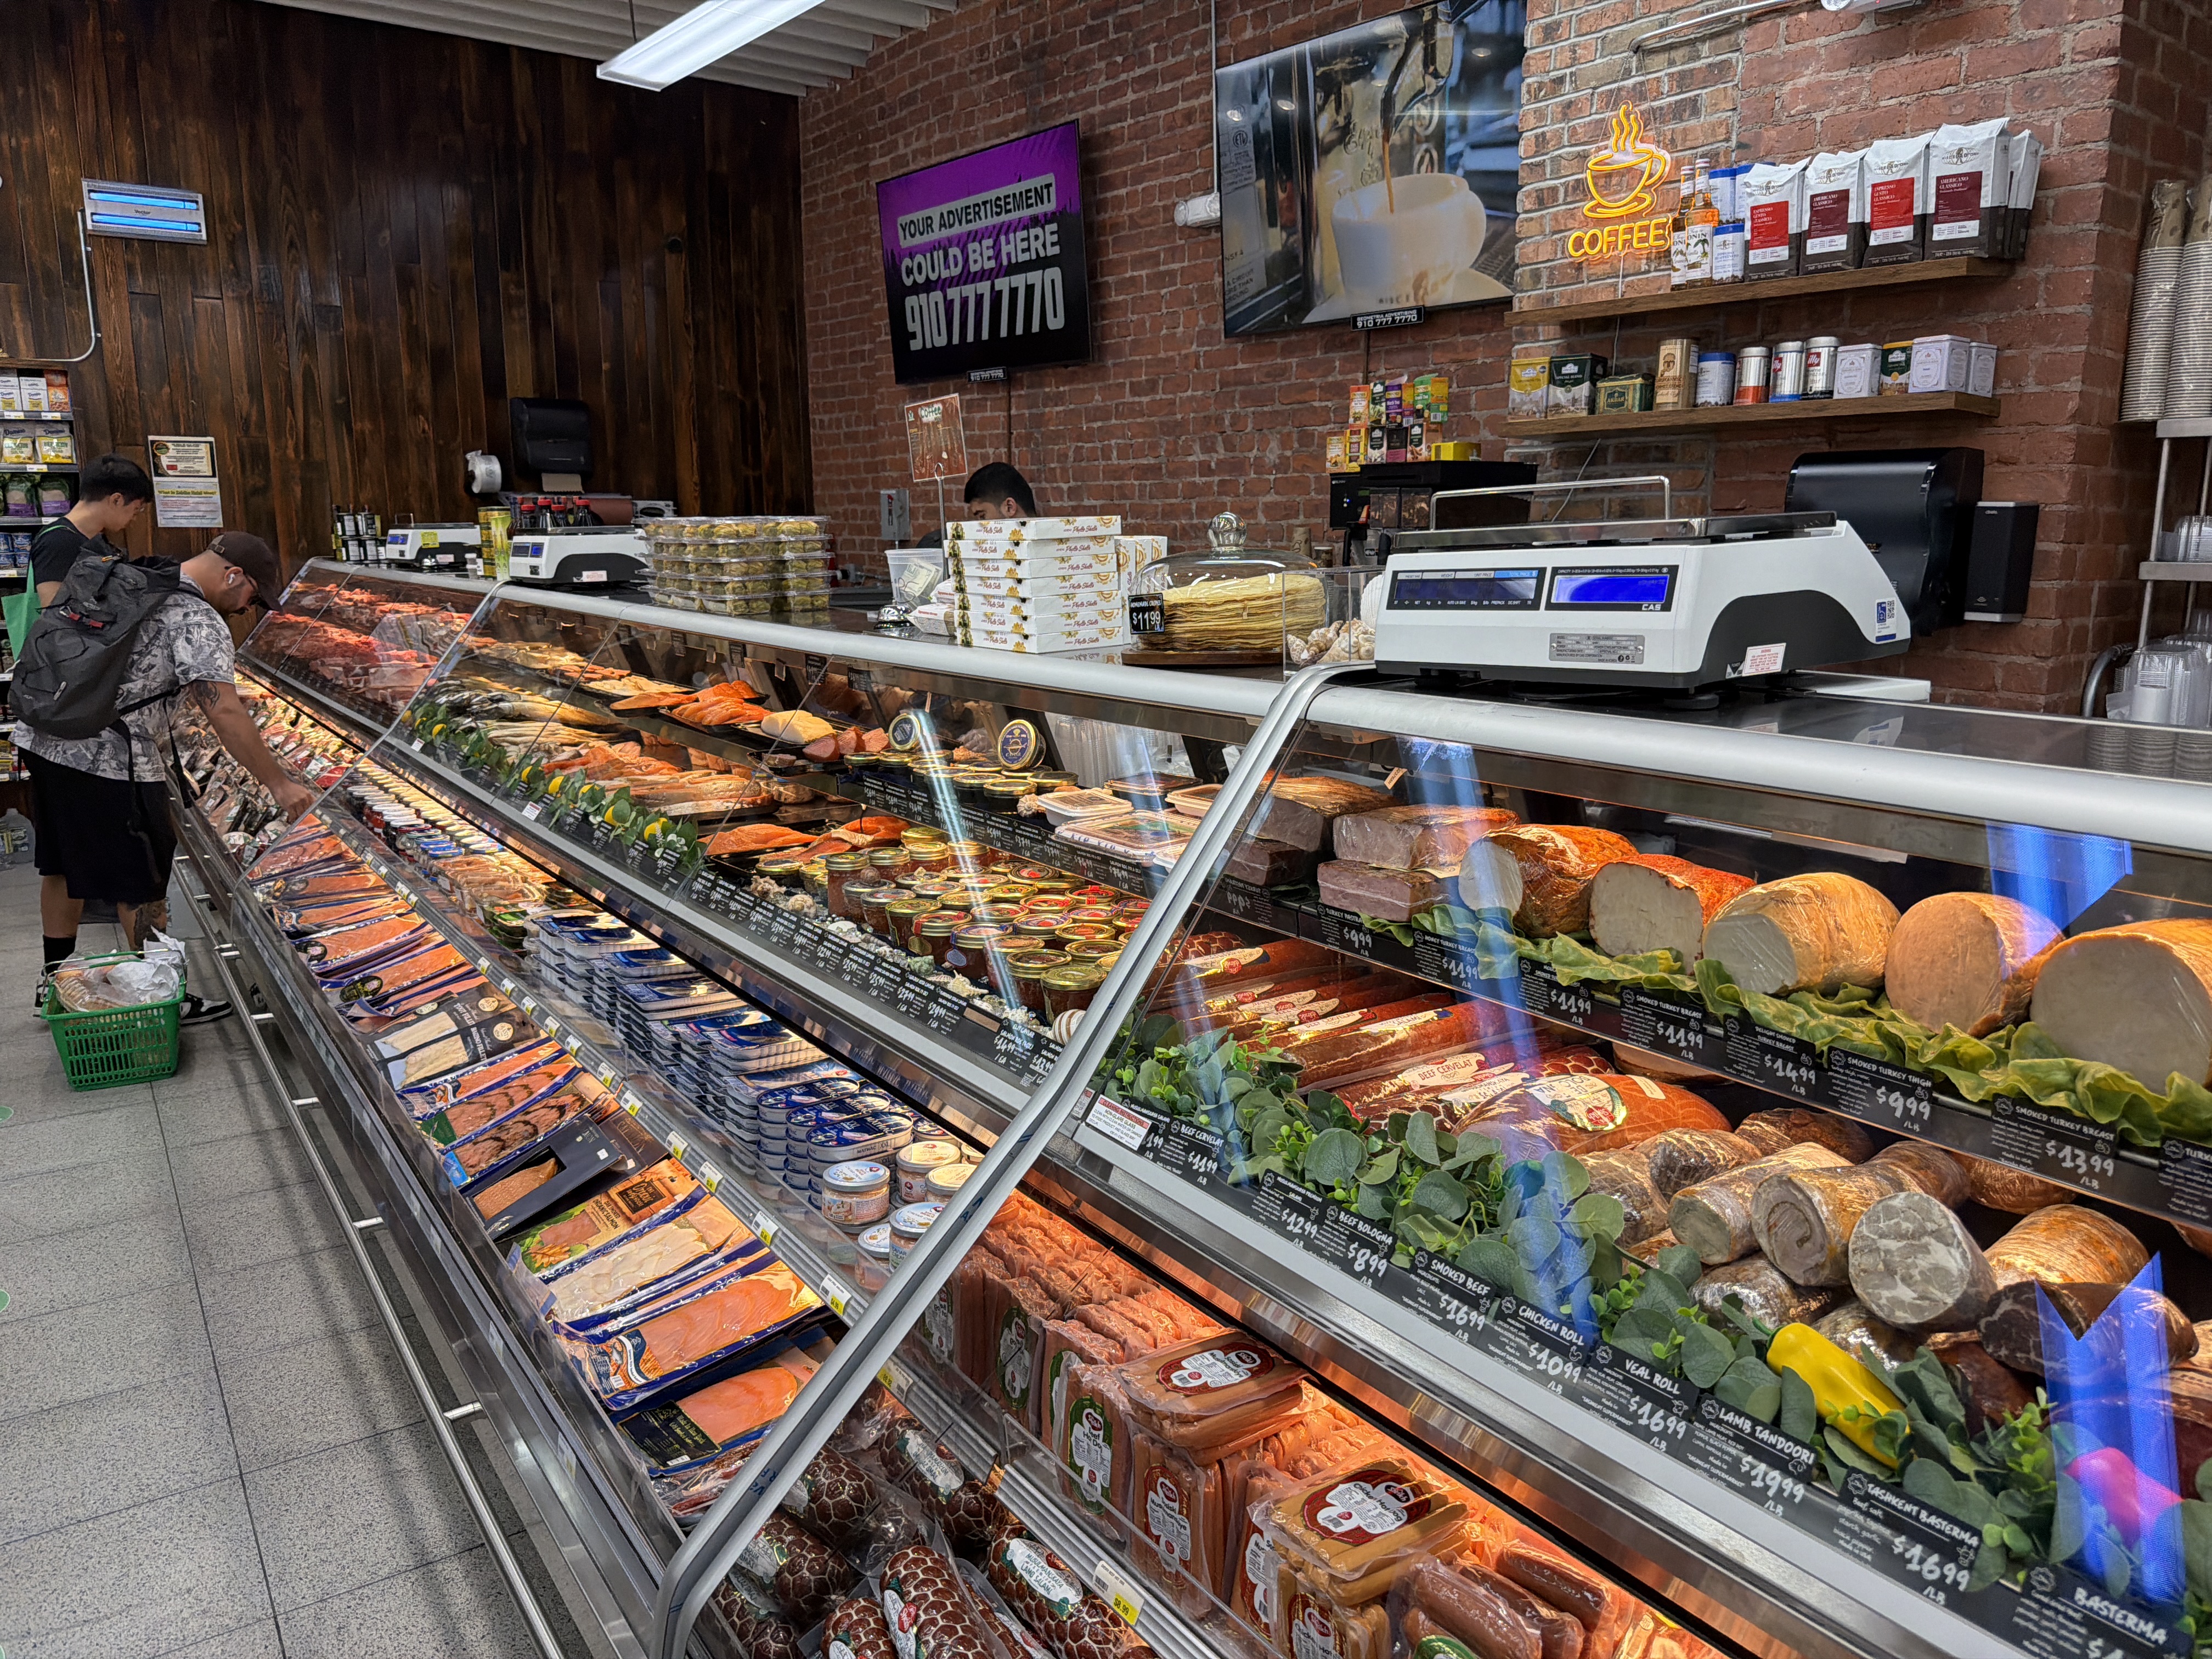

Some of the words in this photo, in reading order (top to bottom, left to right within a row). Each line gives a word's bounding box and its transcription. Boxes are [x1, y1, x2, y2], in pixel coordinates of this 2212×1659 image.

[1940, 176, 1968, 184] AMERICANO
[899, 216, 934, 241] YOUR
[939, 183, 1053, 232] ADVERTISEMENT
[1568, 218, 1667, 258] COFFEE
[1688, 233, 1707, 241] ONIN
[901, 247, 962, 286] COULD
[968, 239, 996, 273] BE
[1001, 223, 1060, 266] HERE
[1357, 320, 1373, 328] 910
[1376, 318, 1392, 326] 777
[1394, 314, 1417, 324] 7770
[1385, 309, 1417, 318] ADVERTISING
[1808, 353, 1820, 366] illy
[920, 405, 941, 418] Coffee
[1133, 611, 1160, 630] $1199
[1326, 907, 1344, 919] TURKEY
[1344, 913, 1363, 923] PASTRA
[1344, 929, 1372, 949] $999
[1425, 935, 1438, 944] HONEY
[1440, 940, 1457, 950] TURKEY
[1458, 945, 1476, 954] BREAST
[1442, 959, 1480, 980] $1199
[1462, 981, 1471, 989] /LB
[1550, 991, 1592, 1015] $1199
[1637, 995, 1658, 1008] SMOKED
[1660, 1001, 1680, 1014] TURKEY
[1681, 1007, 1702, 1019] BREAST
[1572, 1015, 1583, 1026] /LB
[1020, 1027, 1035, 1039] CAVIAR
[1657, 1022, 1703, 1049] $1199
[1756, 1026, 1775, 1038] DELIGHT
[1776, 1032, 1796, 1043] SMOKED
[1757, 1035, 1778, 1047] TURKEY
[1778, 1041, 1794, 1052] BREAST
[1681, 1049, 1694, 1060] /LB
[1418, 1069, 1437, 1082] BEEF
[1437, 1059, 1474, 1075] CERVELAT
[1764, 1054, 1816, 1085] $1499
[1847, 1057, 1877, 1071] SMOKED
[1878, 1066, 1906, 1080] TURKEY
[1908, 1074, 1932, 1087] THIGH
[1791, 1084, 1805, 1096] /LB
[1103, 1101, 1119, 1112] CLEANING
[1119, 1109, 1144, 1126] INSTRUCTIONS
[1876, 1086, 1931, 1121] $999
[1104, 1109, 1124, 1122] NON-GLARE
[1124, 1120, 1136, 1129] GLASS
[1904, 1121, 1920, 1132] /LB
[2016, 1106, 2049, 1121] SMOKED
[2050, 1115, 2081, 1132] TURKEY
[2083, 1126, 2115, 1141] BREAST
[1181, 1124, 1195, 1137] BEEF
[1195, 1130, 1225, 1147] CERVELAT
[1188, 1151, 1218, 1175] $1199
[2045, 1140, 2114, 1177] $1399
[1197, 1176, 1207, 1186] /LB
[2080, 1176, 2099, 1189] /LB
[603, 1212, 620, 1230] SALMON
[1281, 1208, 1318, 1239] $1299
[1339, 1210, 1357, 1228] BEEF
[1357, 1218, 1393, 1245] BOLOGNA
[1293, 1237, 1304, 1249] /LB
[1347, 1242, 1387, 1278] $899
[1360, 1276, 1373, 1287] /LB
[1431, 1259, 1466, 1286] SMOKED
[1466, 1278, 1491, 1295] BEEF
[1439, 1294, 1486, 1331] $1699
[1455, 1329, 1469, 1342] /LB
[1519, 1305, 1559, 1333] CHICKEN
[1560, 1325, 1585, 1346] ROLL
[1528, 1342, 1582, 1383] $1099
[1547, 1380, 1563, 1395] /LB
[1625, 1358, 1651, 1379] VEAL
[1653, 1373, 1680, 1395] ROLL
[1628, 1395, 1687, 1440] $1699
[1650, 1436, 1667, 1452] /LB
[1719, 1407, 1752, 1434] LAMB
[1754, 1426, 1815, 1464] TANDOORI
[1740, 1454, 1806, 1503] $1999
[1353, 1483, 1378, 1503] Chicken
[1376, 1498, 1389, 1512] Hot
[1764, 1499, 1784, 1517] /LB
[1867, 1483, 1920, 1515] TASHKENT
[1919, 1510, 1980, 1547] BASTERMA
[1025, 1553, 1064, 1589] MUSULMANSKAYA
[1892, 1535, 1970, 1592] $1699
[1021, 1563, 1035, 1578] LAMB
[1034, 1575, 1053, 1595] SALAMI
[1114, 1598, 1129, 1616] $8.99
[1923, 1585, 1946, 1606] /LB
[2074, 1587, 2169, 1645] BASTERMA
